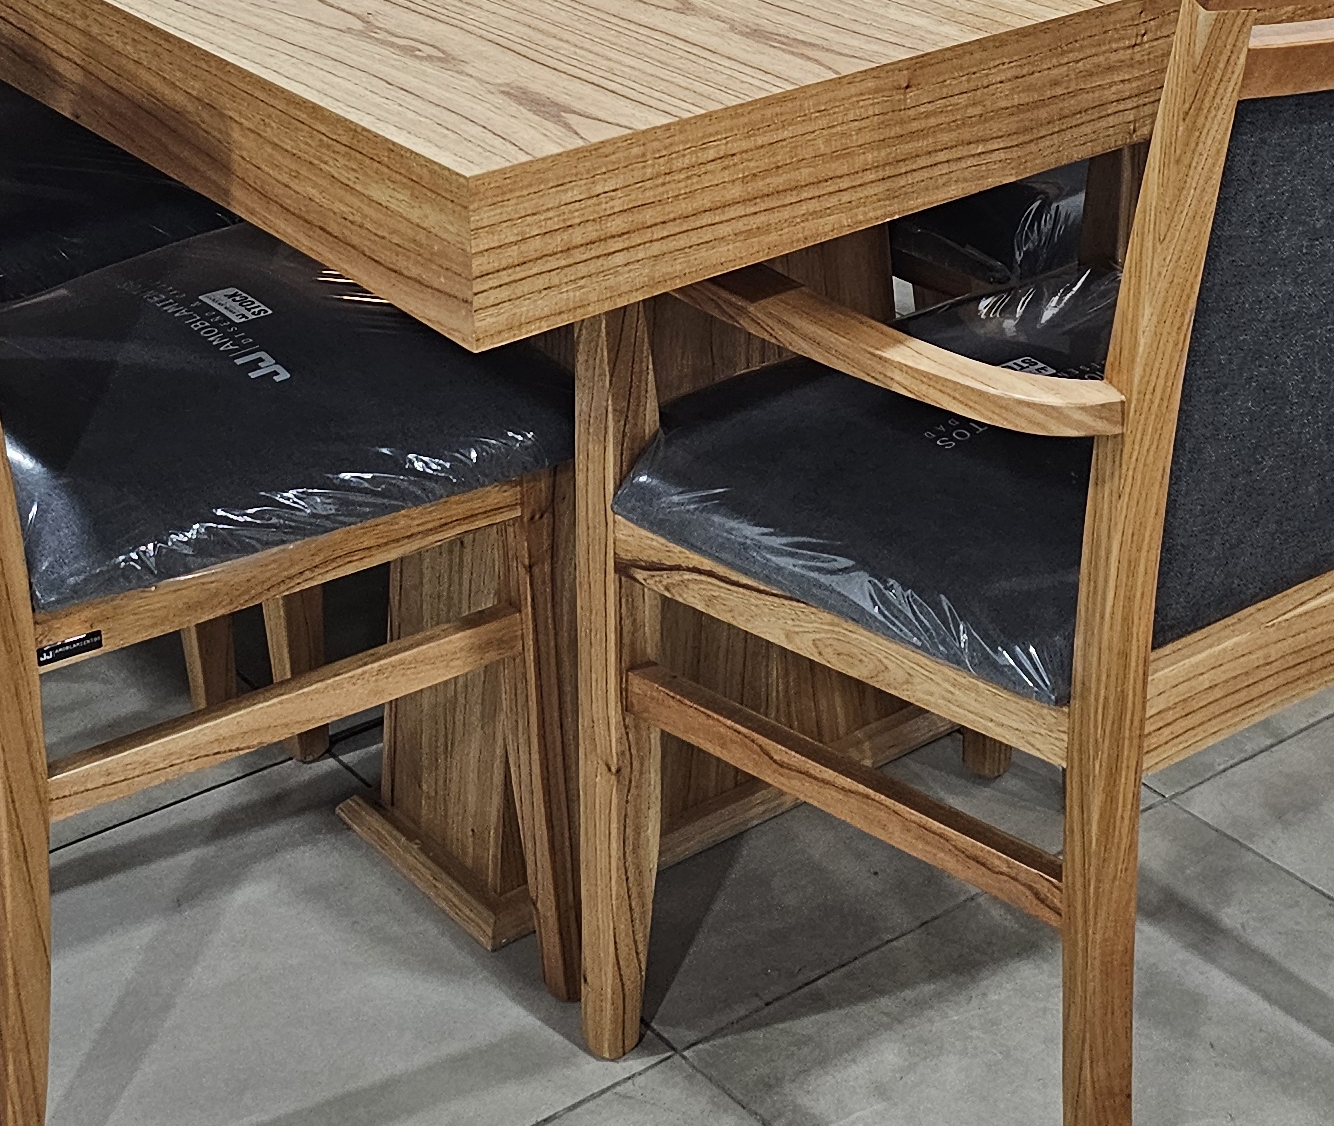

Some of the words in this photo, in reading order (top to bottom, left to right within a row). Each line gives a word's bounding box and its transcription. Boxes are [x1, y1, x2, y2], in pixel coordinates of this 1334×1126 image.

[223, 290, 268, 318] STOCK
[233, 351, 291, 383] JJ
[39, 650, 53, 662] JJ
